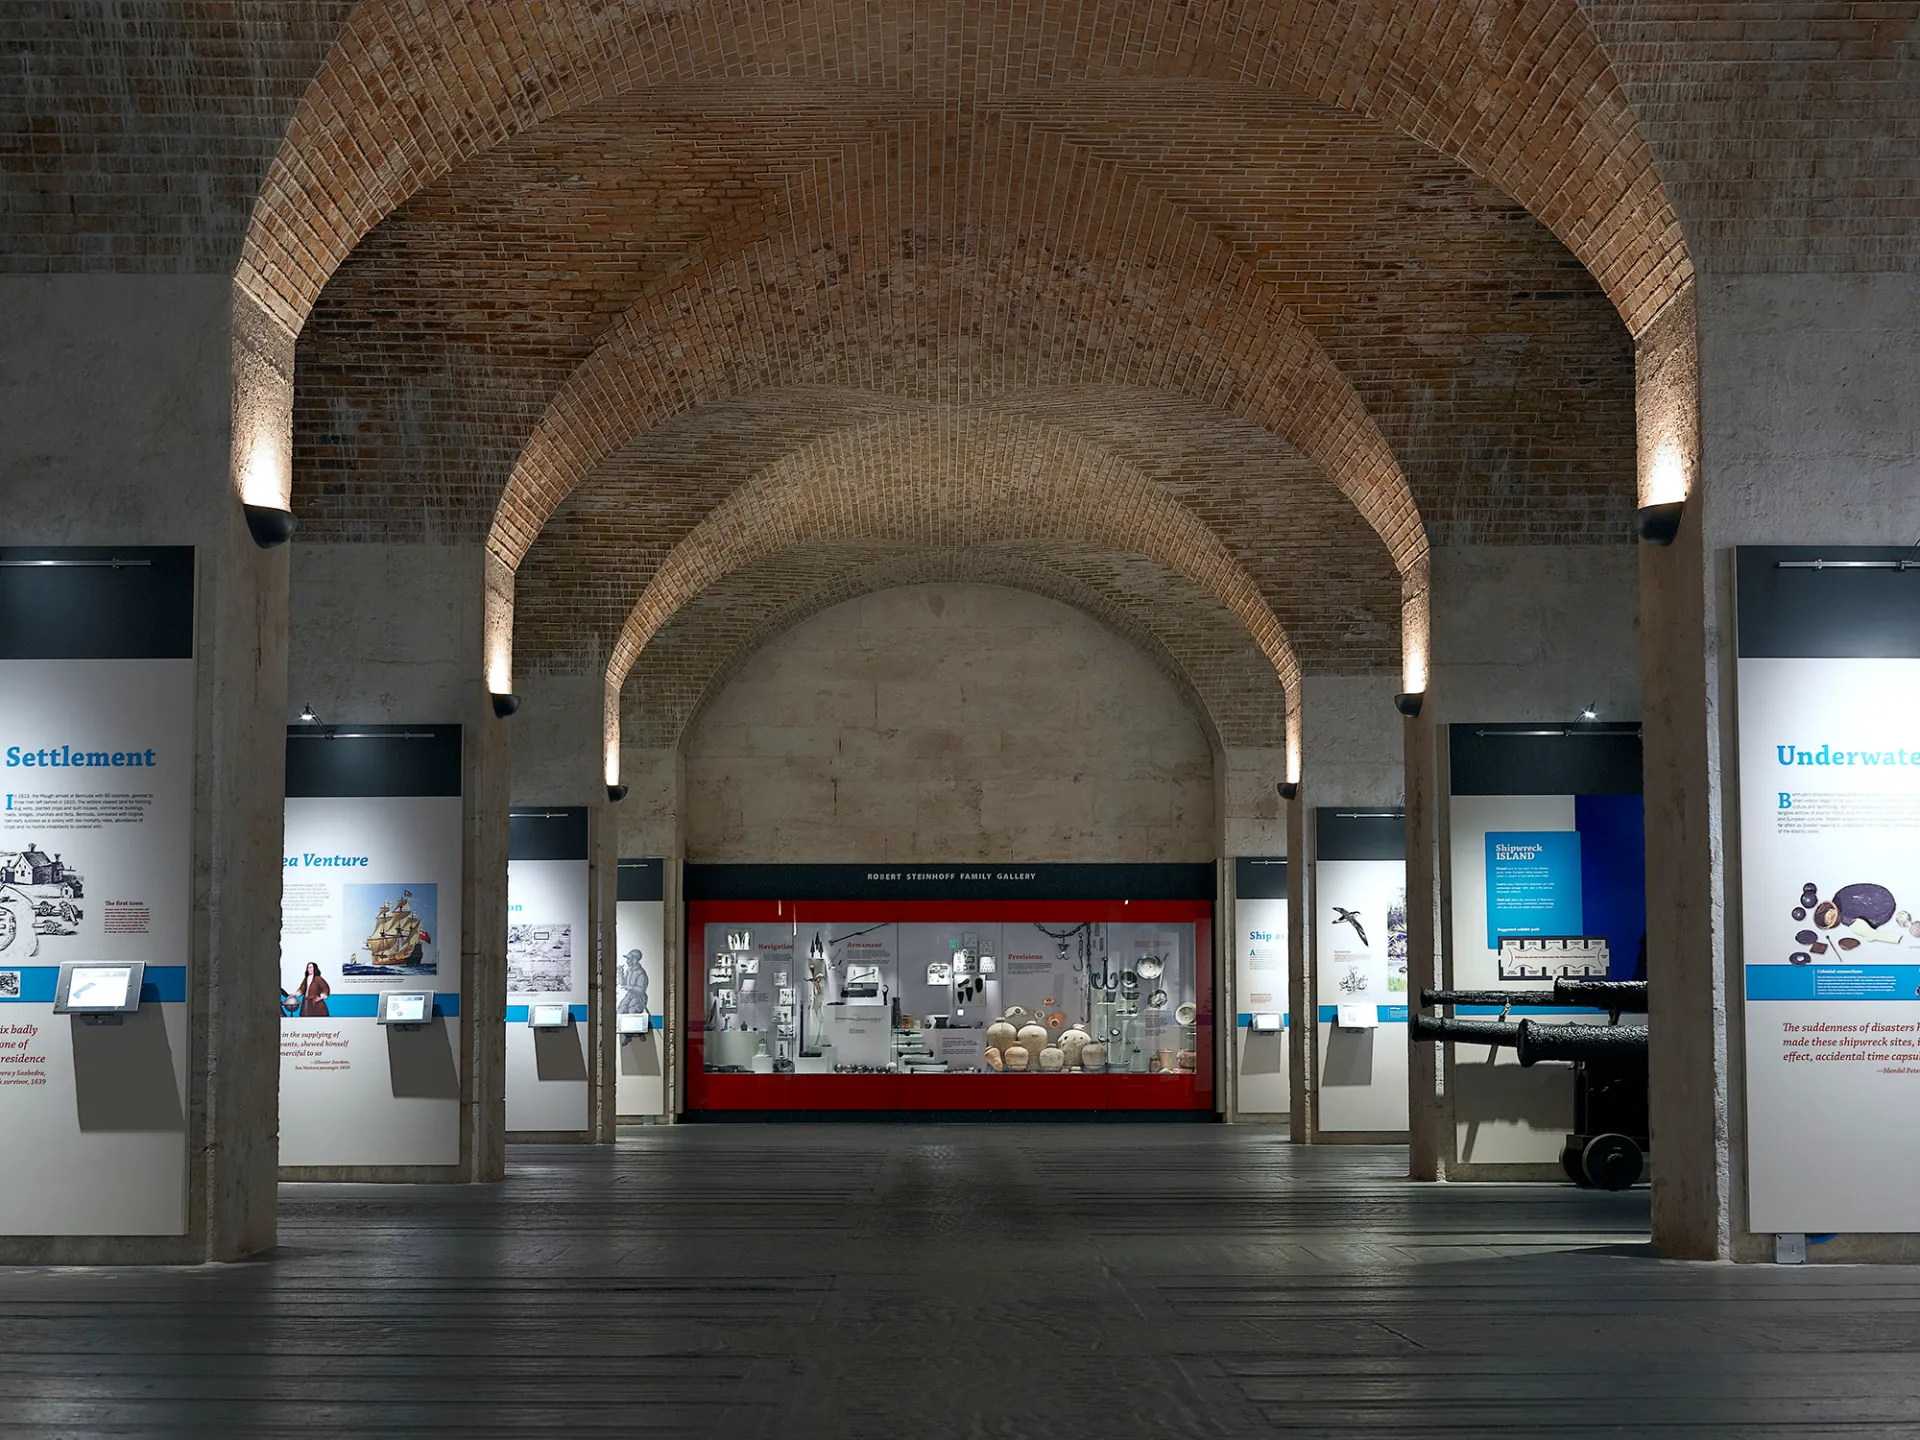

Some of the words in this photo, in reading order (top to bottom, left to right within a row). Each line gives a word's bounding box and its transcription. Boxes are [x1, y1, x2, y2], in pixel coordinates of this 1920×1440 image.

[6, 745, 156, 767] Settlement
[1496, 844, 1543, 854] Shipwreck
[303, 853, 369, 866] Venture
[1496, 852, 1535, 860] ISLAND
[1250, 931, 1272, 942] Ship
[11, 1024, 38, 1036] badly
[1783, 1022, 1800, 1032] The
[1801, 1022, 1858, 1032] suddenness
[1859, 1022, 1871, 1034] of
[1871, 1022, 1915, 1032] disasters
[301, 1031, 332, 1039] supplying
[333, 1030, 341, 1038] of
[18, 1039, 30, 1050] of
[325, 1040, 350, 1048] himself
[1783, 1036, 1810, 1046] made
[1811, 1036, 1838, 1046] these
[1839, 1036, 1888, 1049] shipwreck
[1890, 1037, 1915, 1048] sites,
[1, 1053, 46, 1063] residence
[280, 1049, 306, 1057] merciful
[1783, 1051, 1813, 1063] effect,
[1815, 1051, 1866, 1061] accidental
[1867, 1051, 1890, 1061] time
[16, 1069, 46, 1077] Saabedra,
